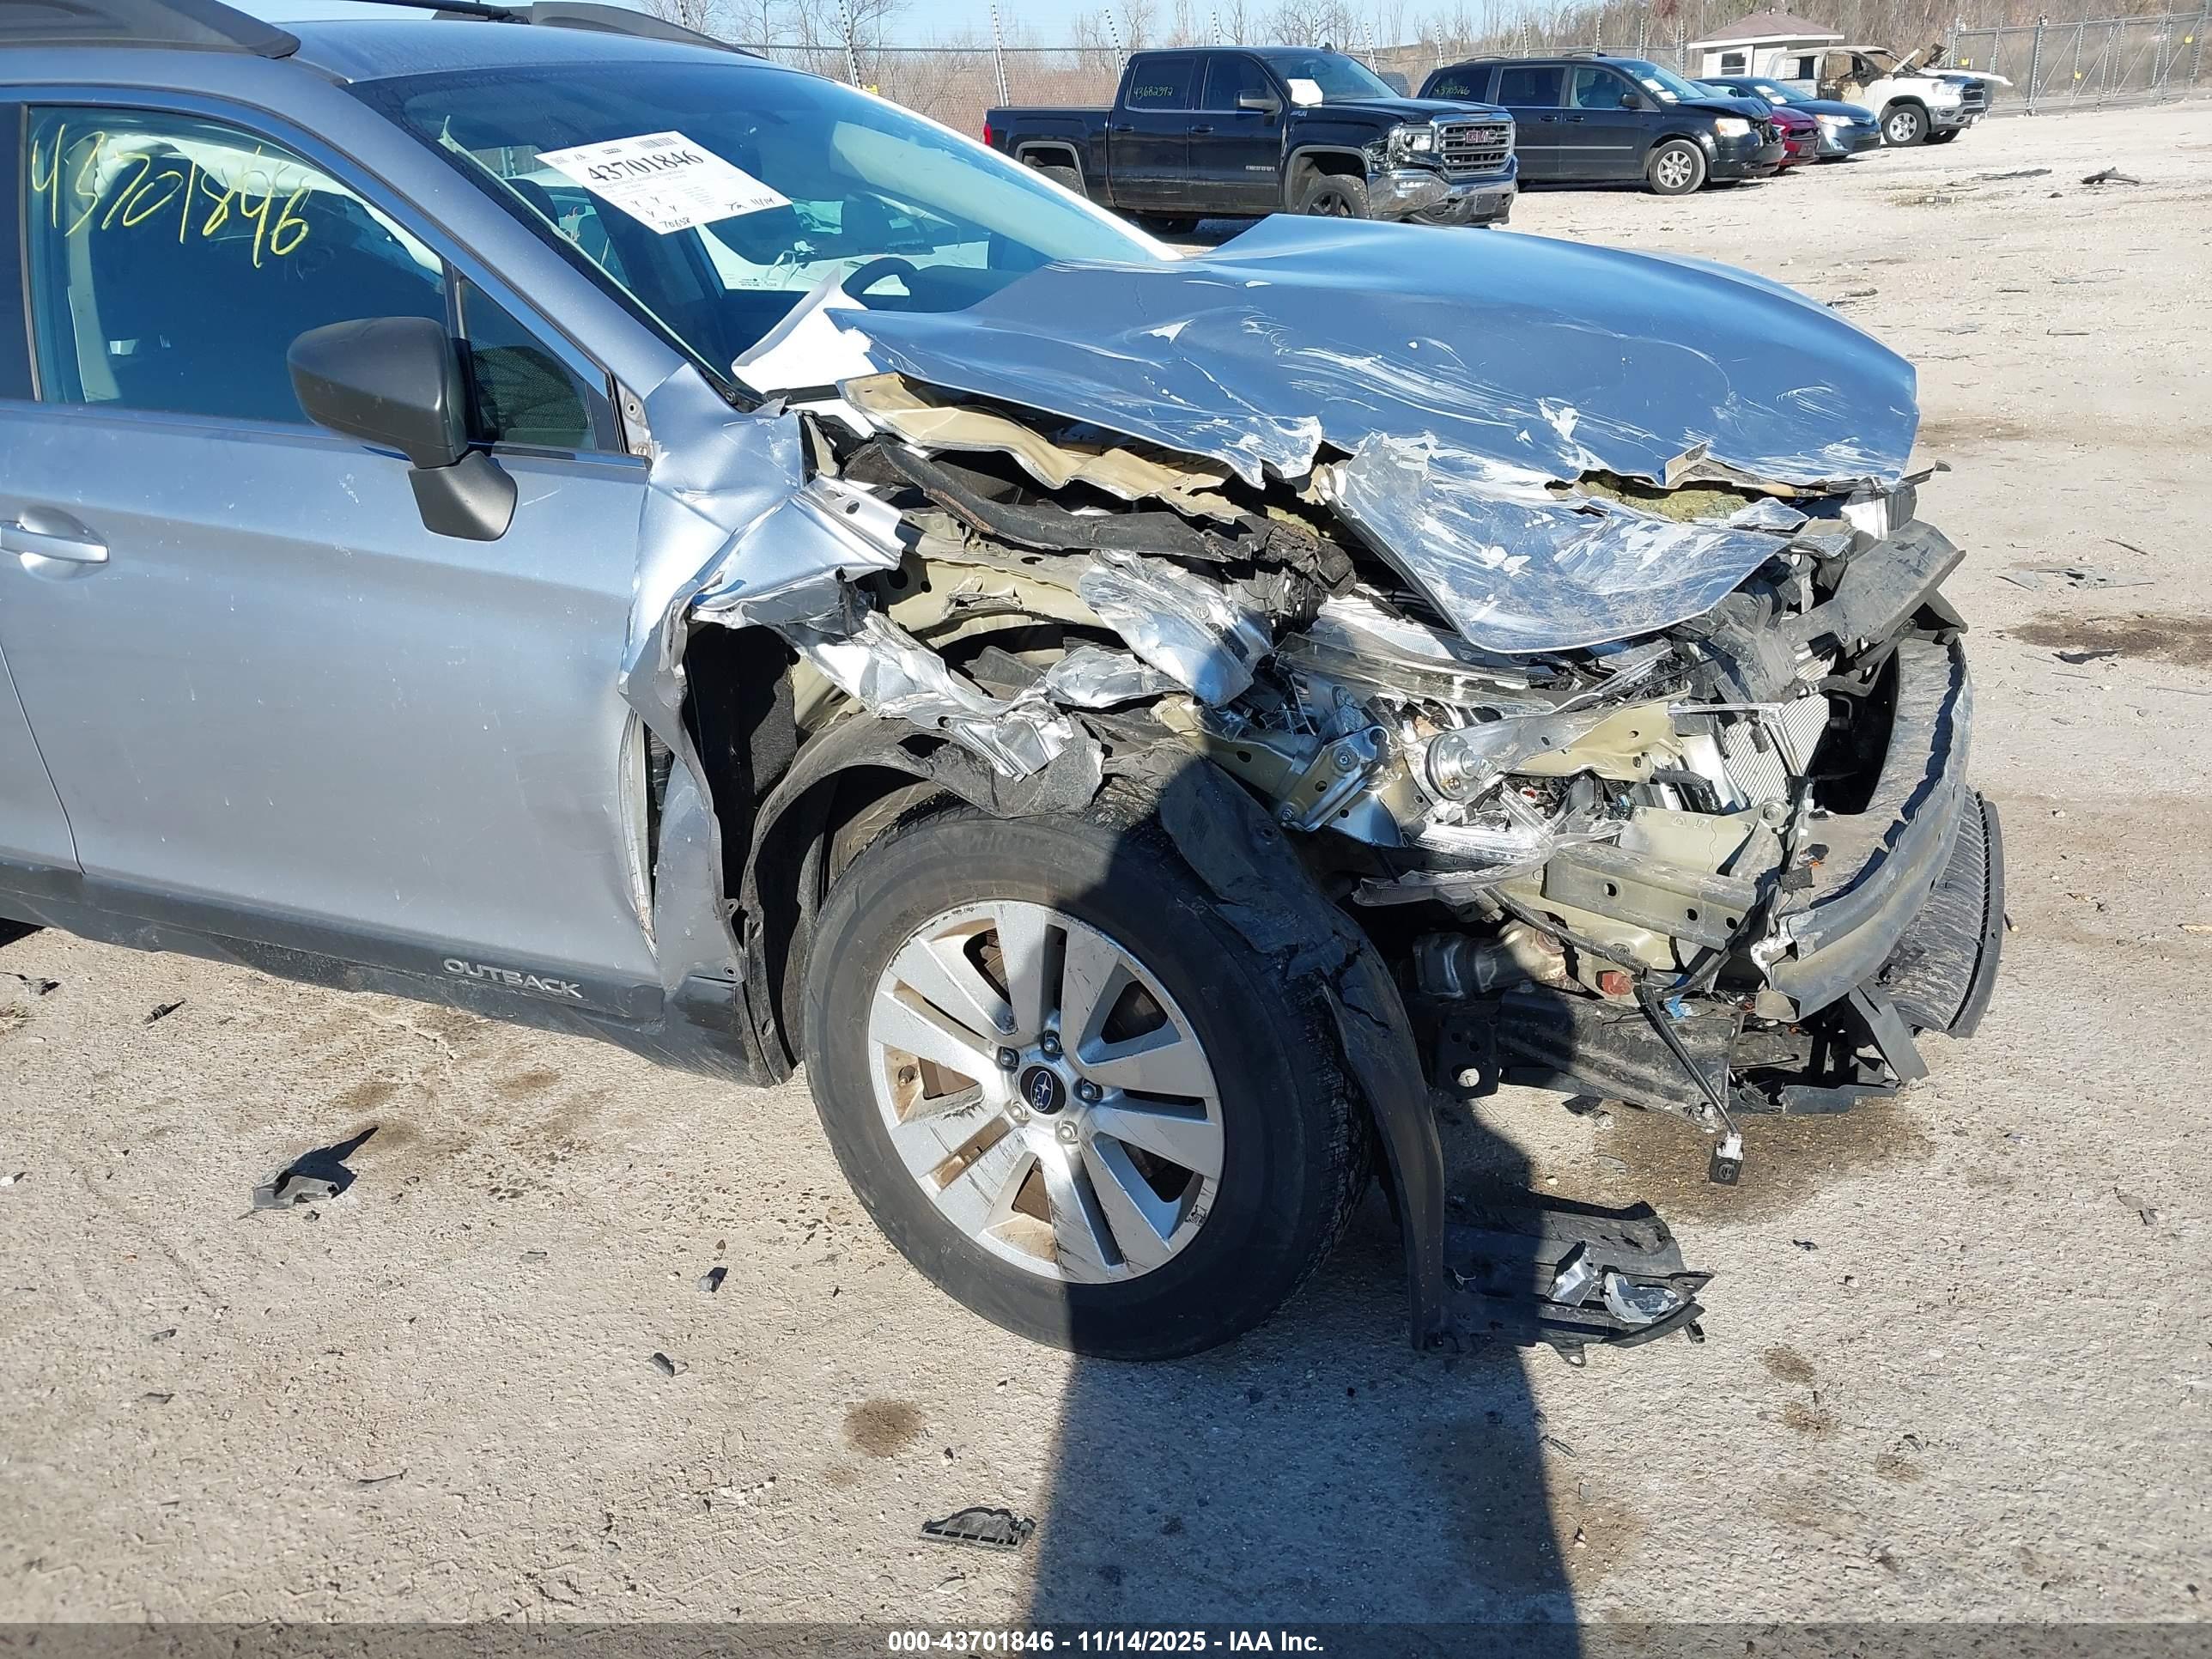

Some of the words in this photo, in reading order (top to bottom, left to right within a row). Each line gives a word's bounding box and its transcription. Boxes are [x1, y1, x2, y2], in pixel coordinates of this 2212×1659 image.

[1466, 129, 1496, 143] GMC
[587, 149, 704, 181] 43701846
[31, 123, 313, 269] 43701846
[442, 957, 584, 999] OUTBACK
